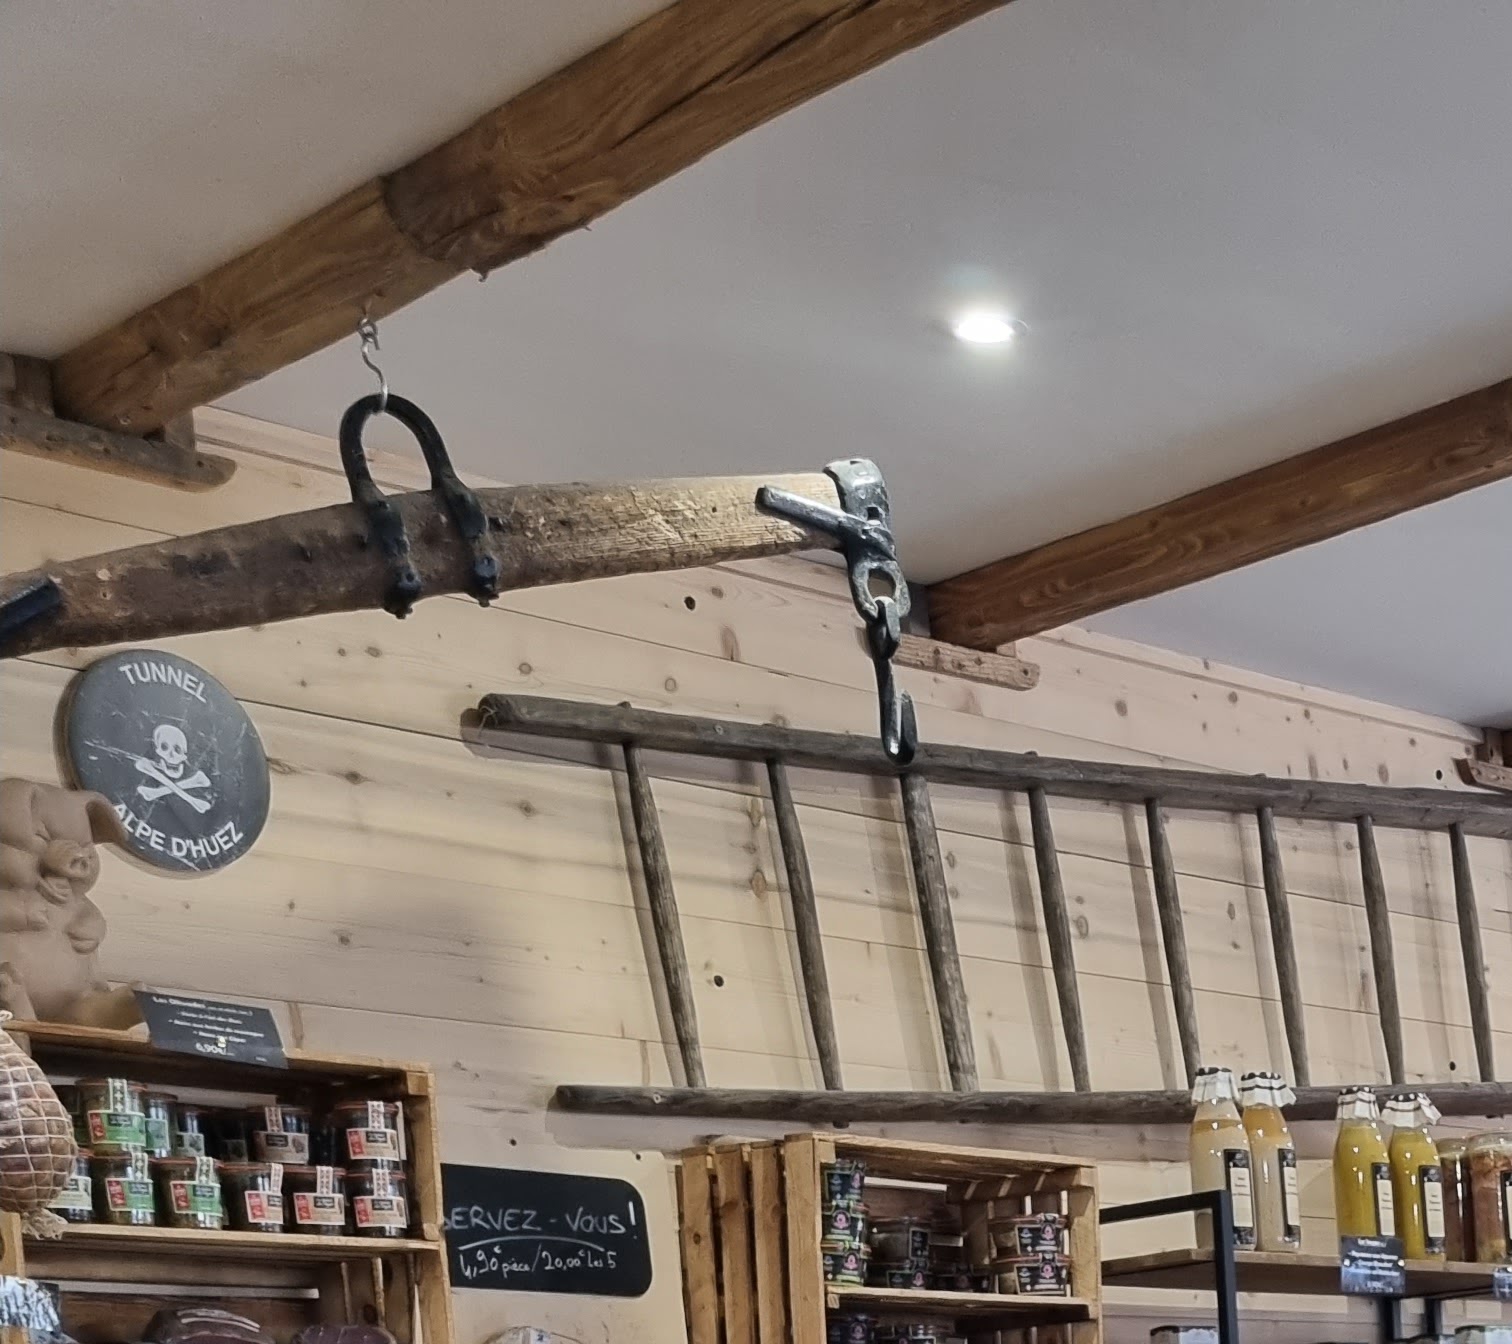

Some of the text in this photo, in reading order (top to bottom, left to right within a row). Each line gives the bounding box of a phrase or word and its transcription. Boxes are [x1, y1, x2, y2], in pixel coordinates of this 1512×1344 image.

[119, 662, 206, 703] TUNNEL
[114, 803, 243, 859] ALPE D'HUEZ
[606, 1251, 617, 1269] 5
